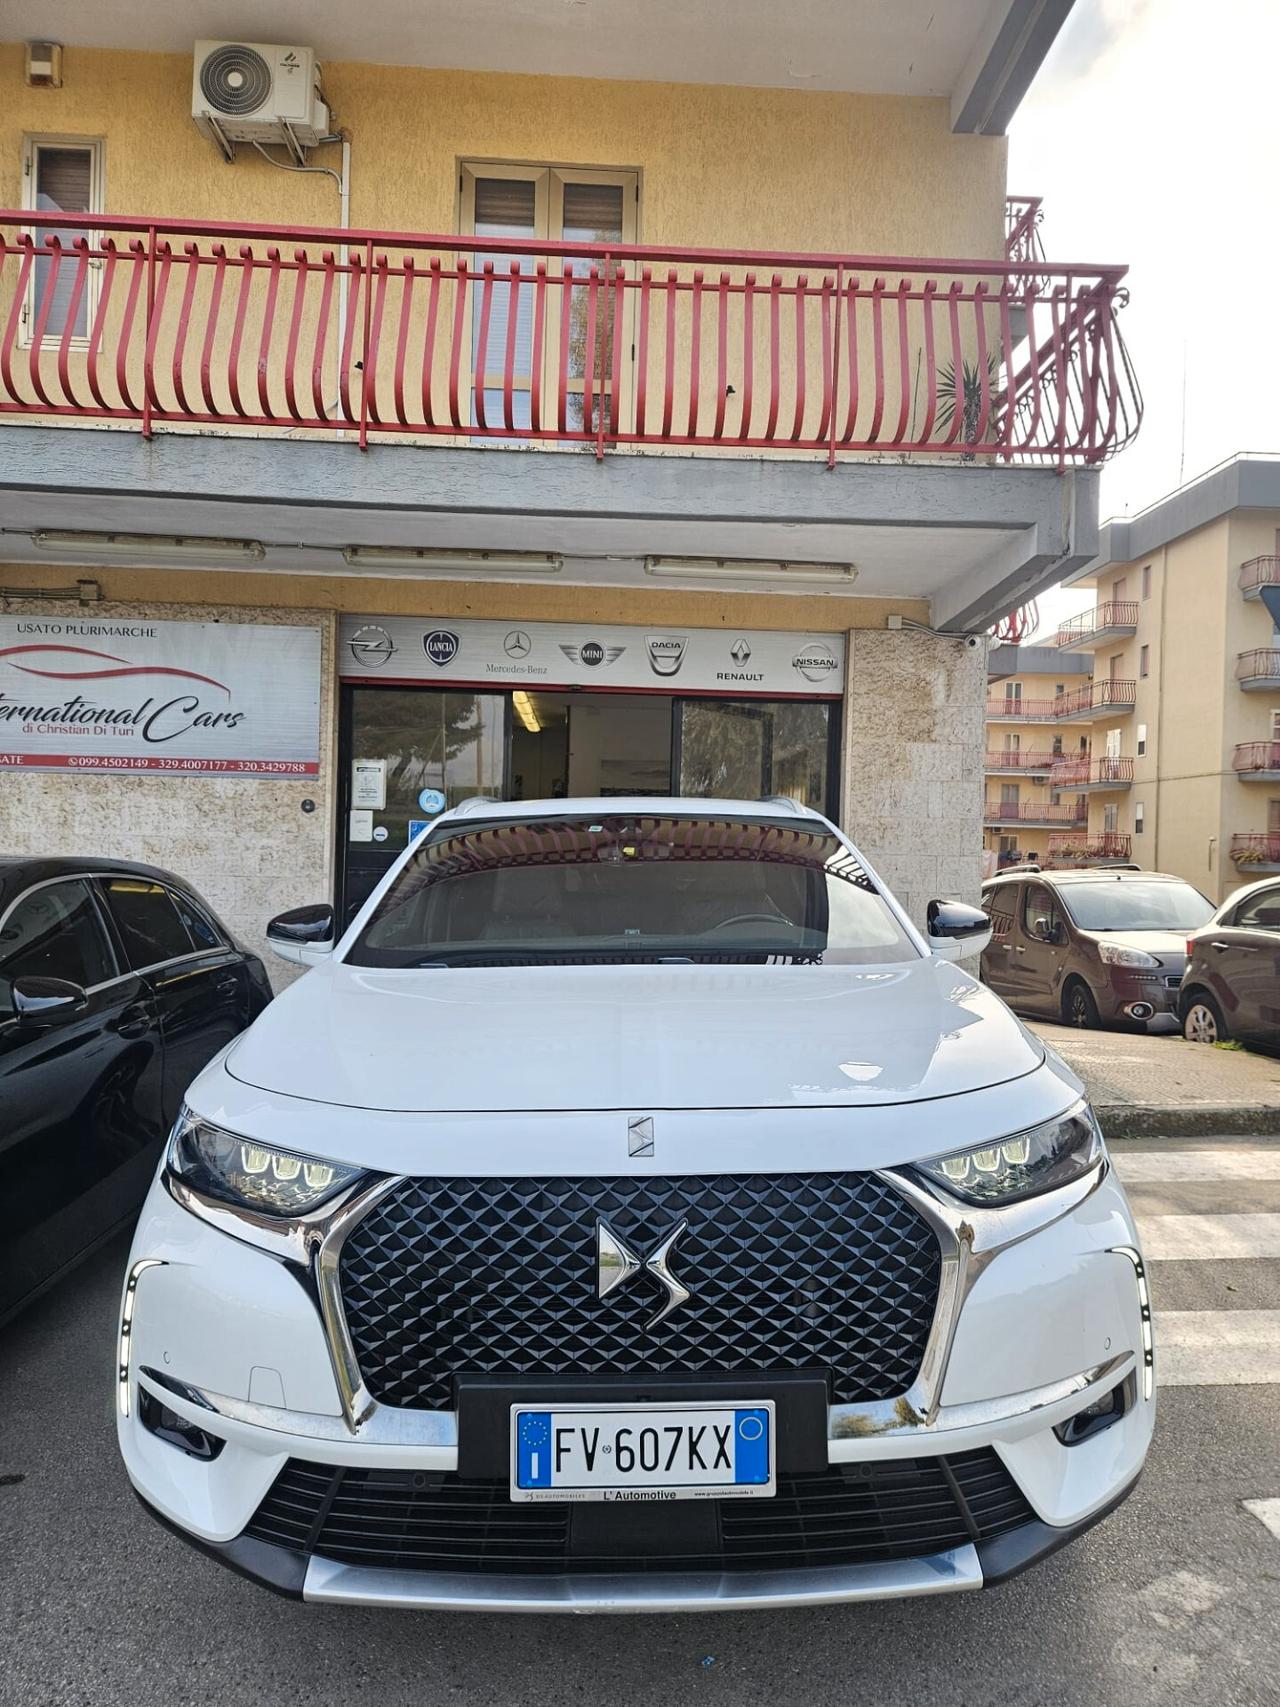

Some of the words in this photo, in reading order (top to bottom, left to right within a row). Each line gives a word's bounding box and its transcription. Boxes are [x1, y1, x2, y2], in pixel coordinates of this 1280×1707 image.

[17, 623, 62, 635] USATO
[66, 624, 158, 638] PLURIMARCHE
[429, 641, 453, 652] LANCIA
[651, 641, 681, 650] DACIA
[582, 650, 604, 660] MINI
[796, 658, 834, 667] NISSAN
[486, 664, 547, 675] Mercedes-Benz
[716, 672, 764, 682] RENAULT
[142, 695, 247, 743] Cars
[22, 723, 34, 734] di
[37, 724, 90, 735] Christian
[93, 725, 107, 736] Di
[111, 726, 134, 737] Turi
[79, 757, 149, 769] 099.4502149
[159, 759, 228, 771] 329.4007177
[237, 761, 306, 773] 320.3429788
[615, 1489, 677, 1501] Automotive
